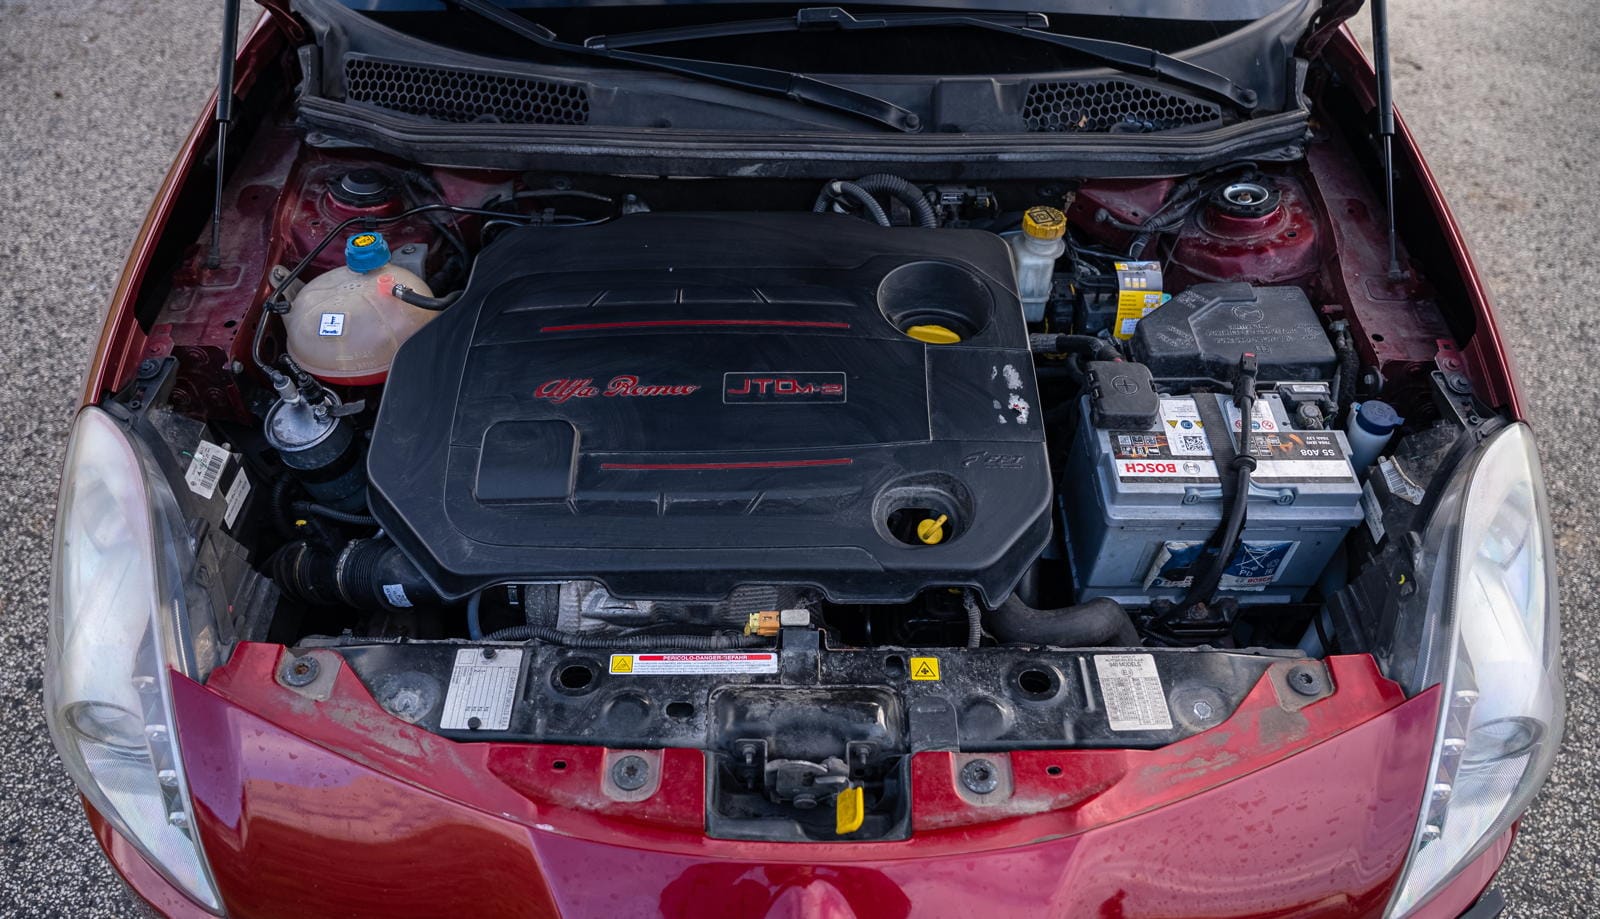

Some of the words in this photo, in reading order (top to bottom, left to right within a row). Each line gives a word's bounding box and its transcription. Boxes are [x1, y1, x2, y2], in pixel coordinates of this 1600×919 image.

[533, 377, 599, 405] Alfa
[602, 374, 701, 397] Romeo
[1300, 448, 1319, 456] A08
[1321, 448, 1335, 456] S5
[1125, 463, 1177, 473] BOSCH
